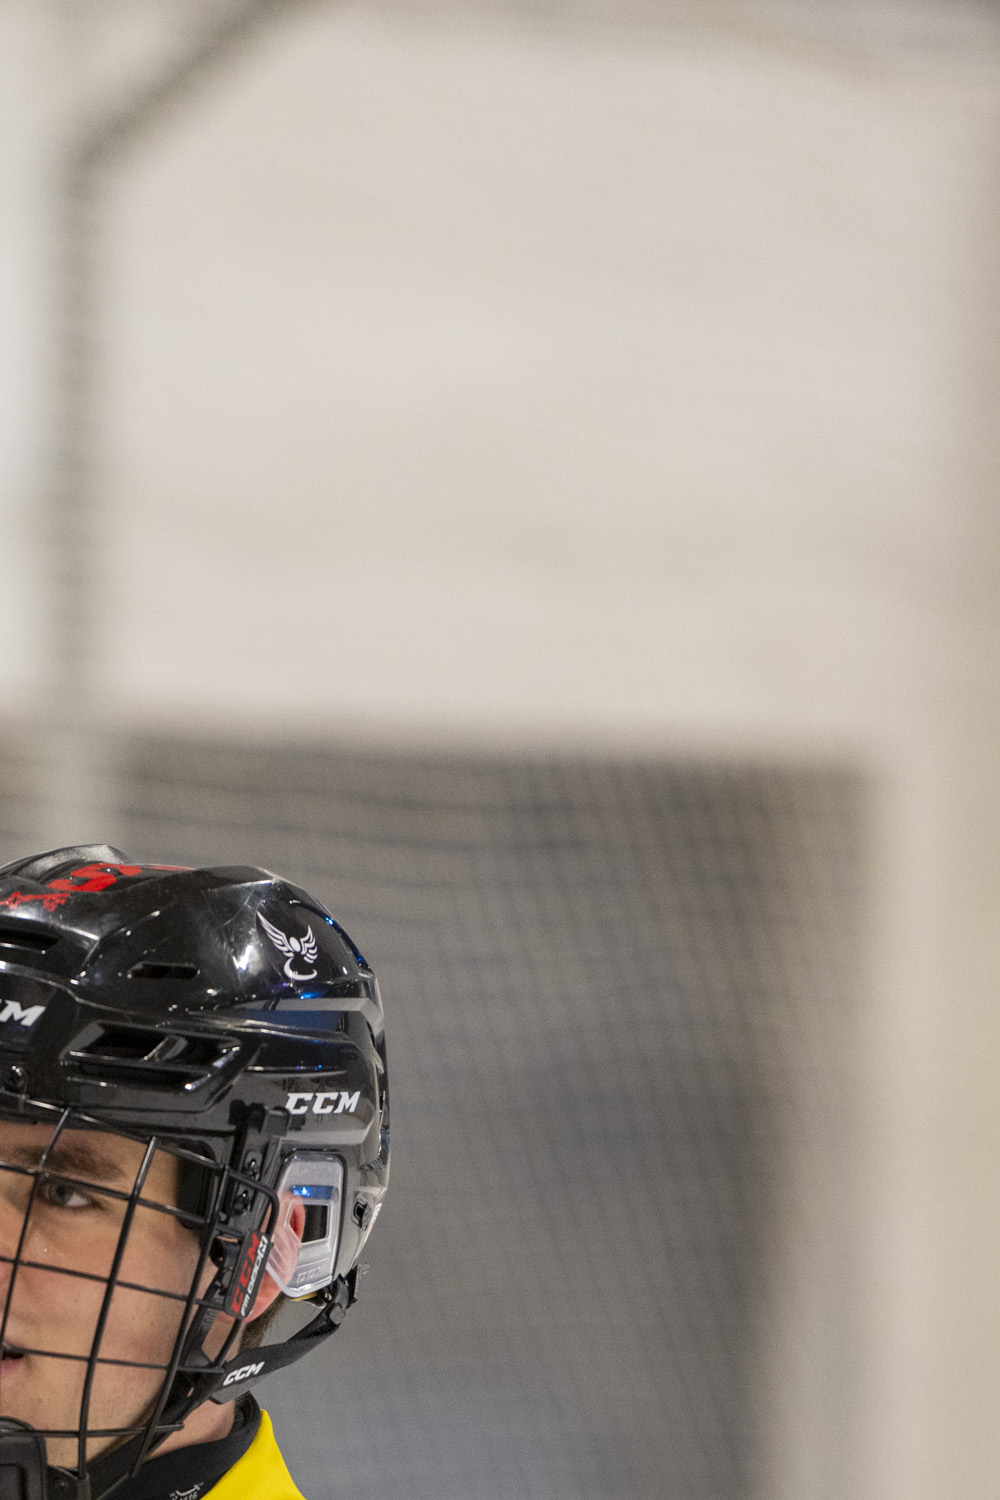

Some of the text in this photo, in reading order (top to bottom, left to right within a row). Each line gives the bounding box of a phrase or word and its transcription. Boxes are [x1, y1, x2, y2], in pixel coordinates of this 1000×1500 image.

[284, 1091, 361, 1115] CCM
[231, 1232, 260, 1313] CCM
[223, 1361, 265, 1387] CCM
